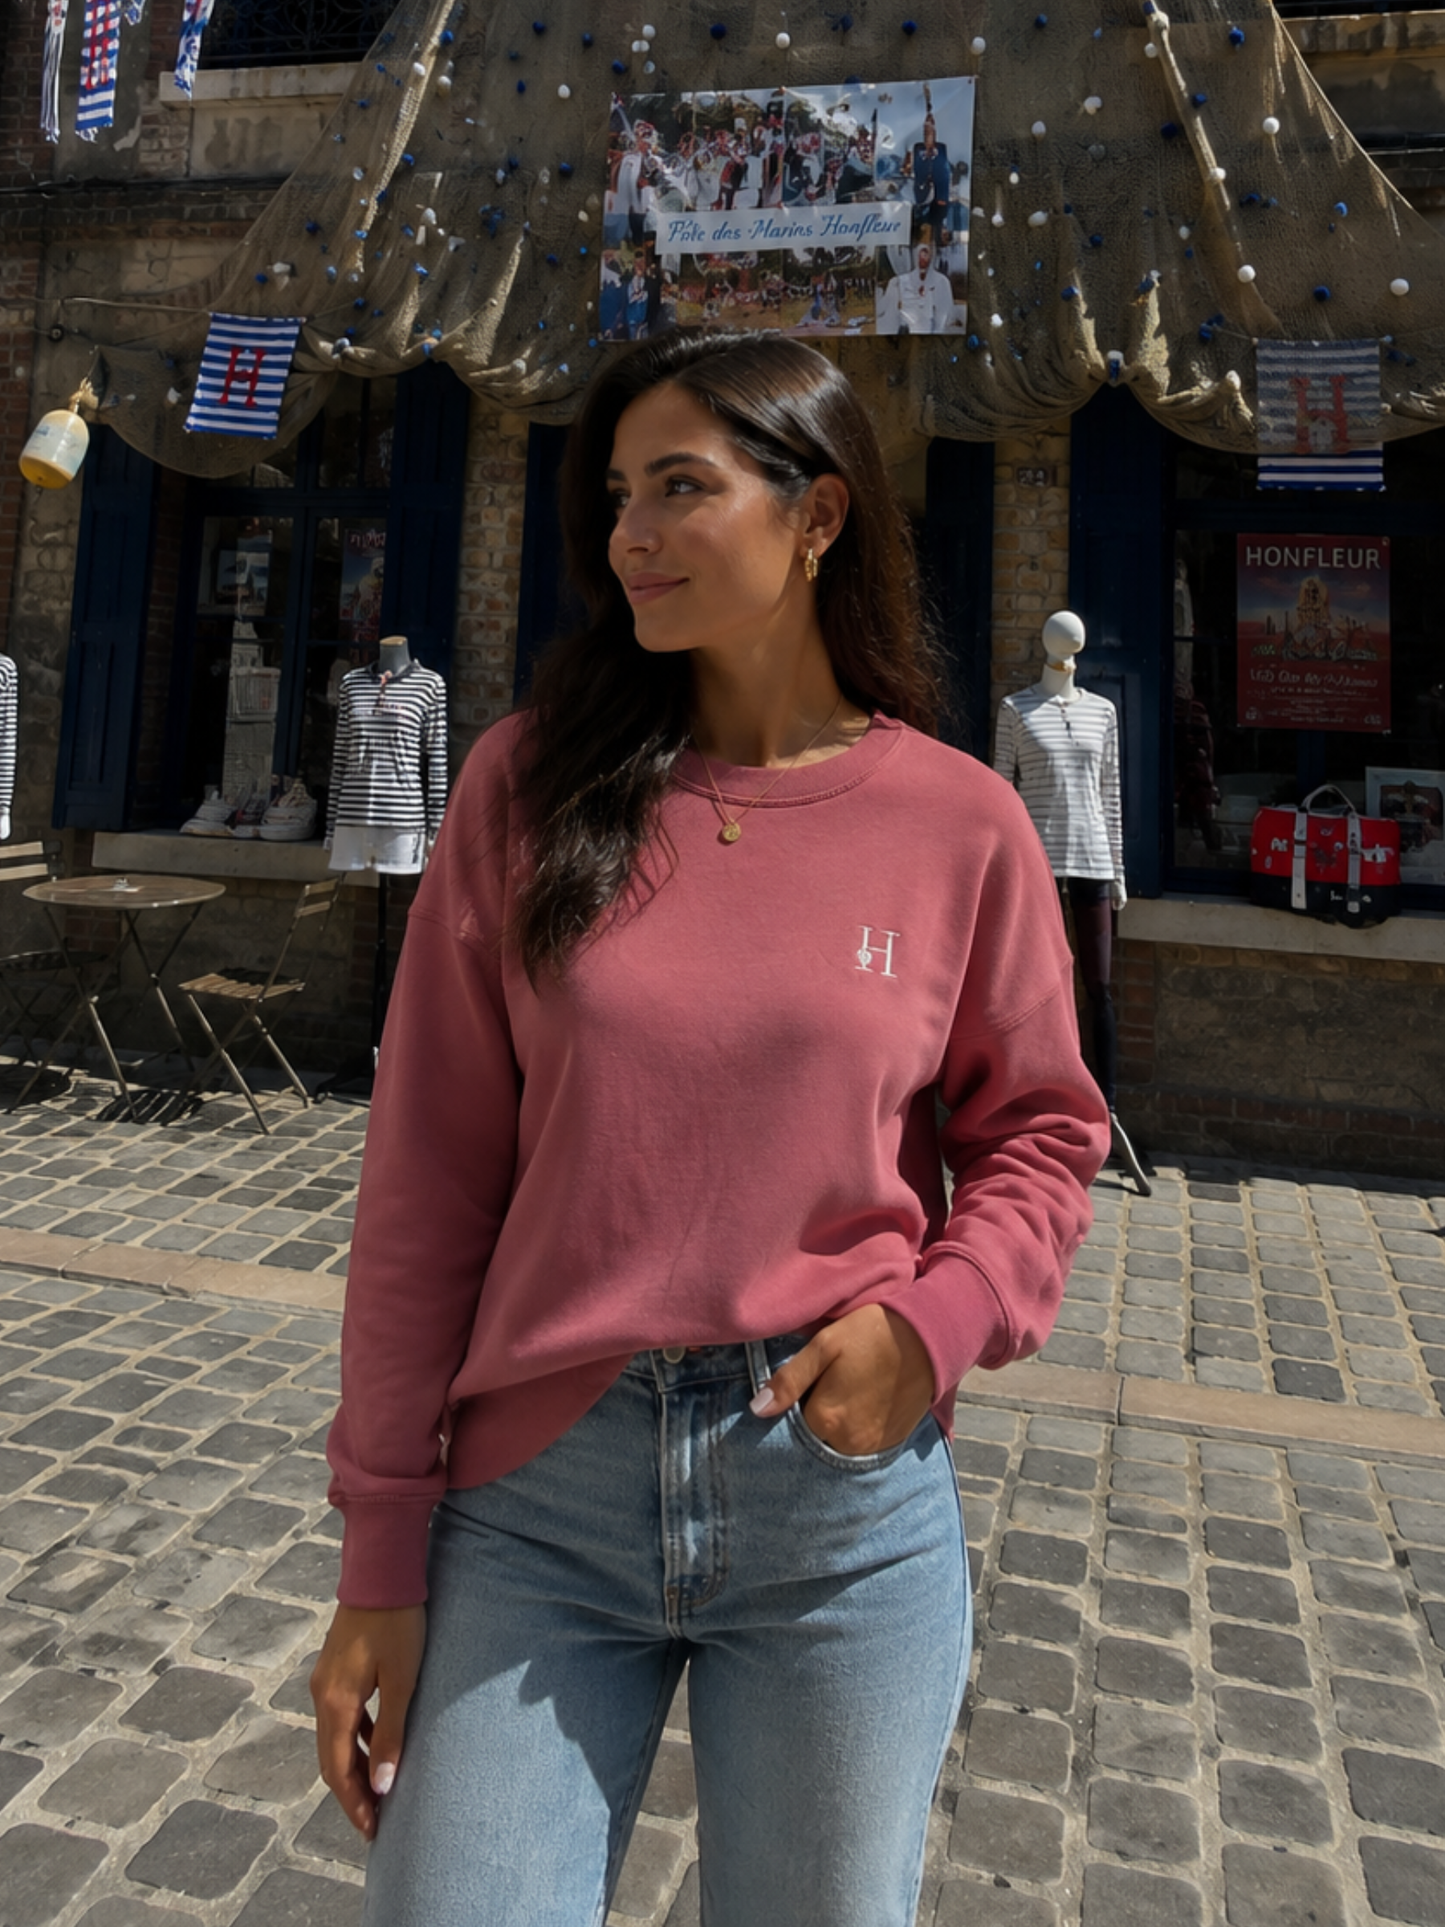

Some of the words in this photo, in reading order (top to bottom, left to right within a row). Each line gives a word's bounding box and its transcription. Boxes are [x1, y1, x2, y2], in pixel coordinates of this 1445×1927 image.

[711, 221, 742, 241] des
[749, 218, 813, 240] Marins
[820, 213, 901, 242] Honfleur
[1246, 545, 1381, 570] HONFLEUR
[854, 925, 901, 978] H
